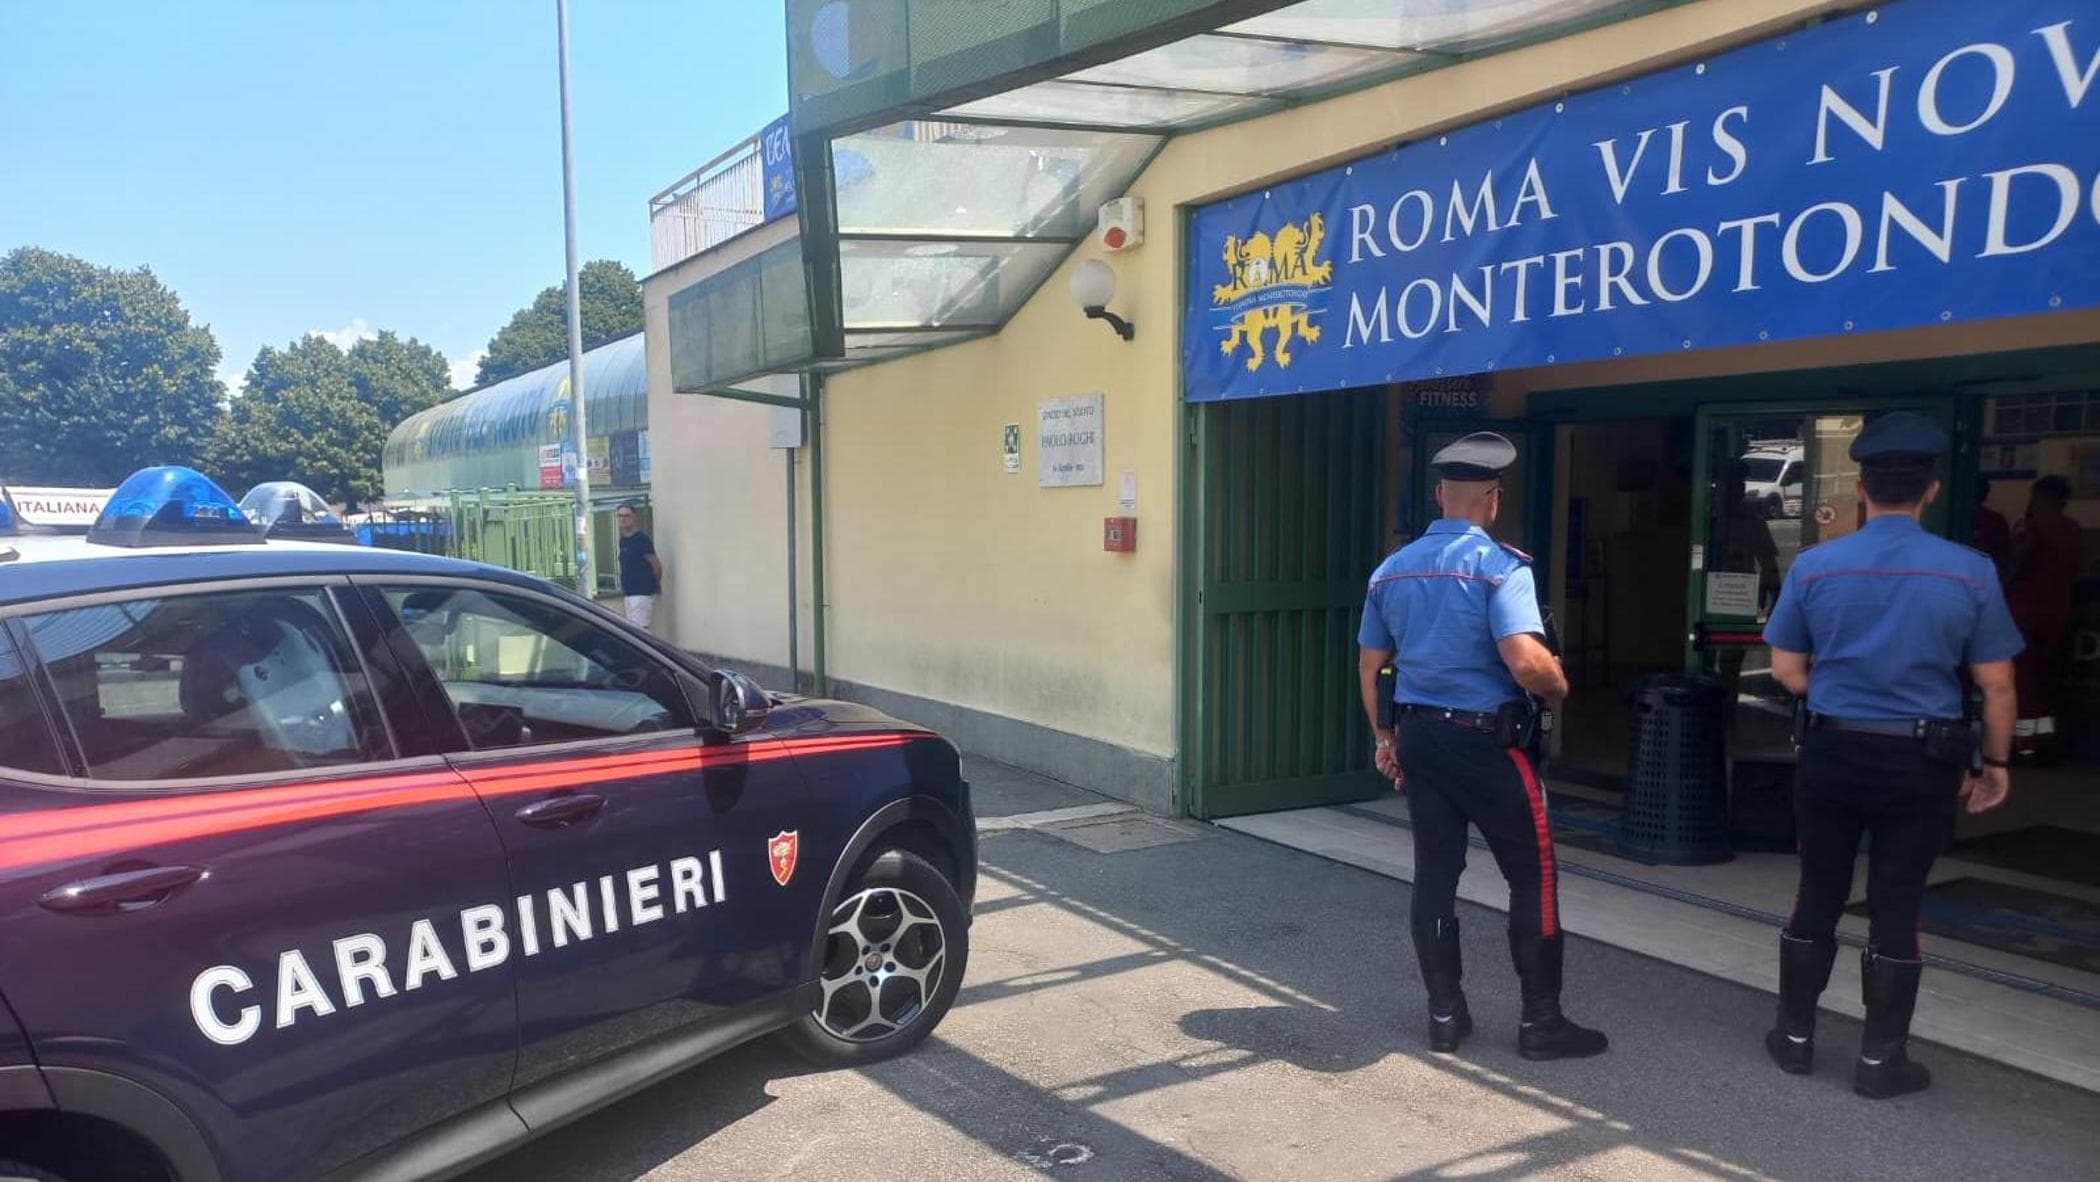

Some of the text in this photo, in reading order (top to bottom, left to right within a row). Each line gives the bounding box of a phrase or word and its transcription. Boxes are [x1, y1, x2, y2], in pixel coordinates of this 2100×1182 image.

[1341, 163, 2100, 348] MONTEROTOND
[1347, 157, 1558, 263] ROMA
[1593, 106, 1749, 205] VIS
[1420, 391, 1478, 408] FITNESS
[17, 500, 100, 513] ITALIANA
[190, 849, 727, 1045] CARABINIERI
